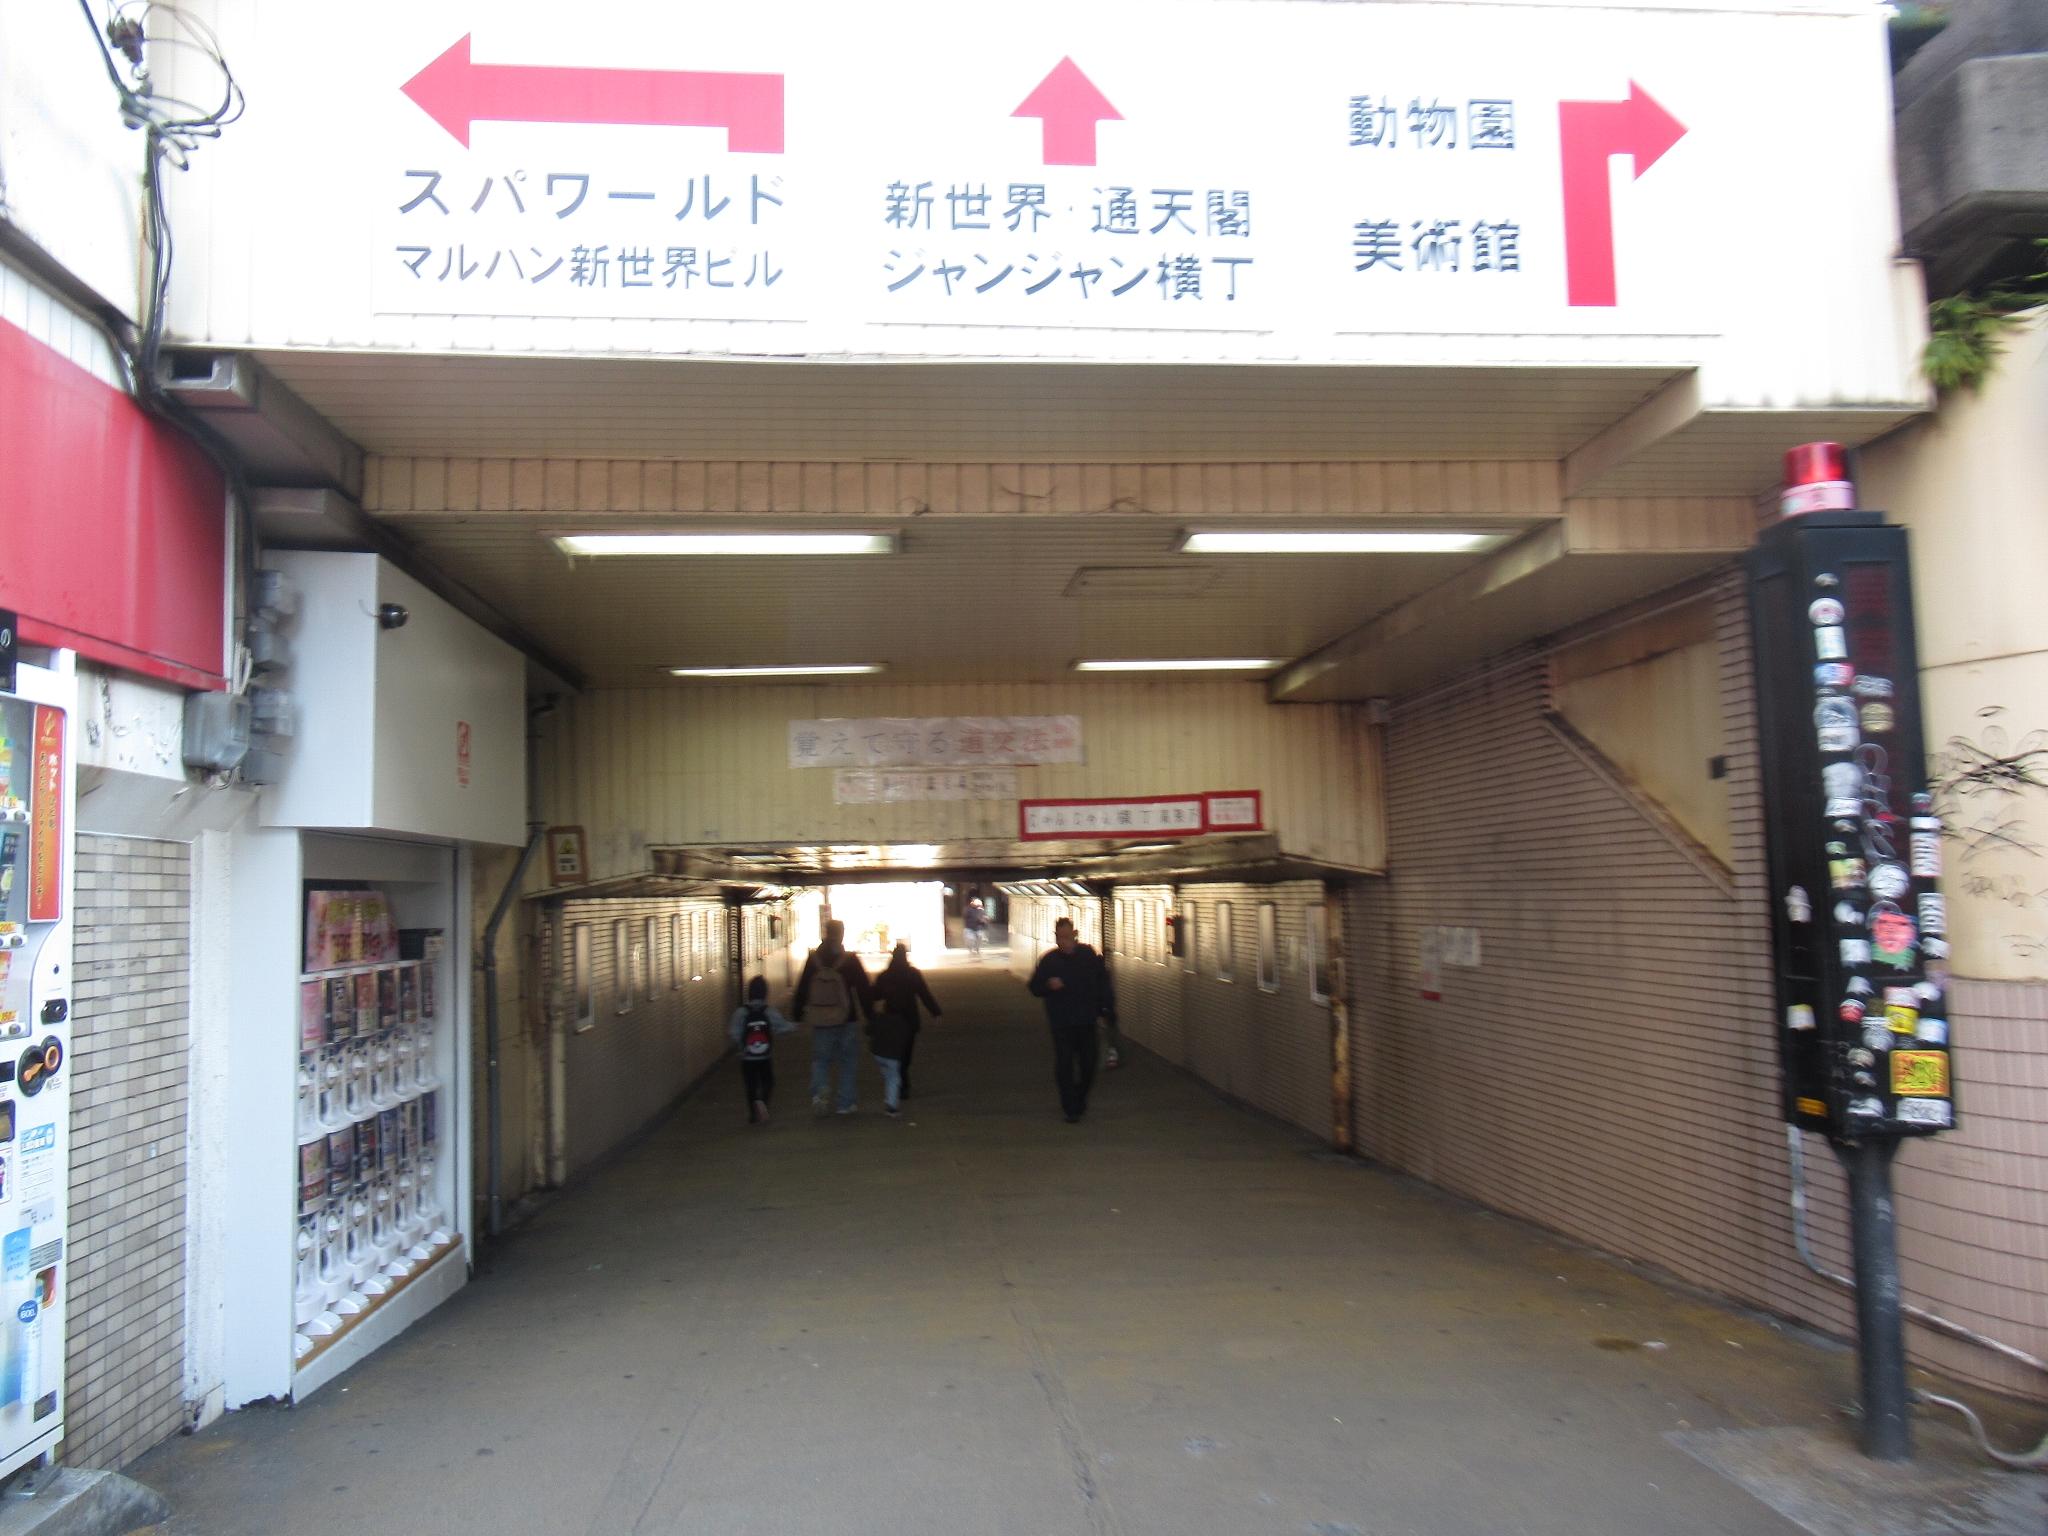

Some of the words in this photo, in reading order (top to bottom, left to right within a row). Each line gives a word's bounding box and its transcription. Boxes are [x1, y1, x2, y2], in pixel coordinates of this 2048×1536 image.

[1349, 95, 1515, 150] 動物園
[399, 169, 784, 224] スパワールド
[885, 180, 1251, 237] 新世界・通天閣
[395, 244, 784, 289] マルハン新世界ビル
[1352, 219, 1521, 273] 美術館
[883, 249, 1255, 301] ジャンジャン横丁
